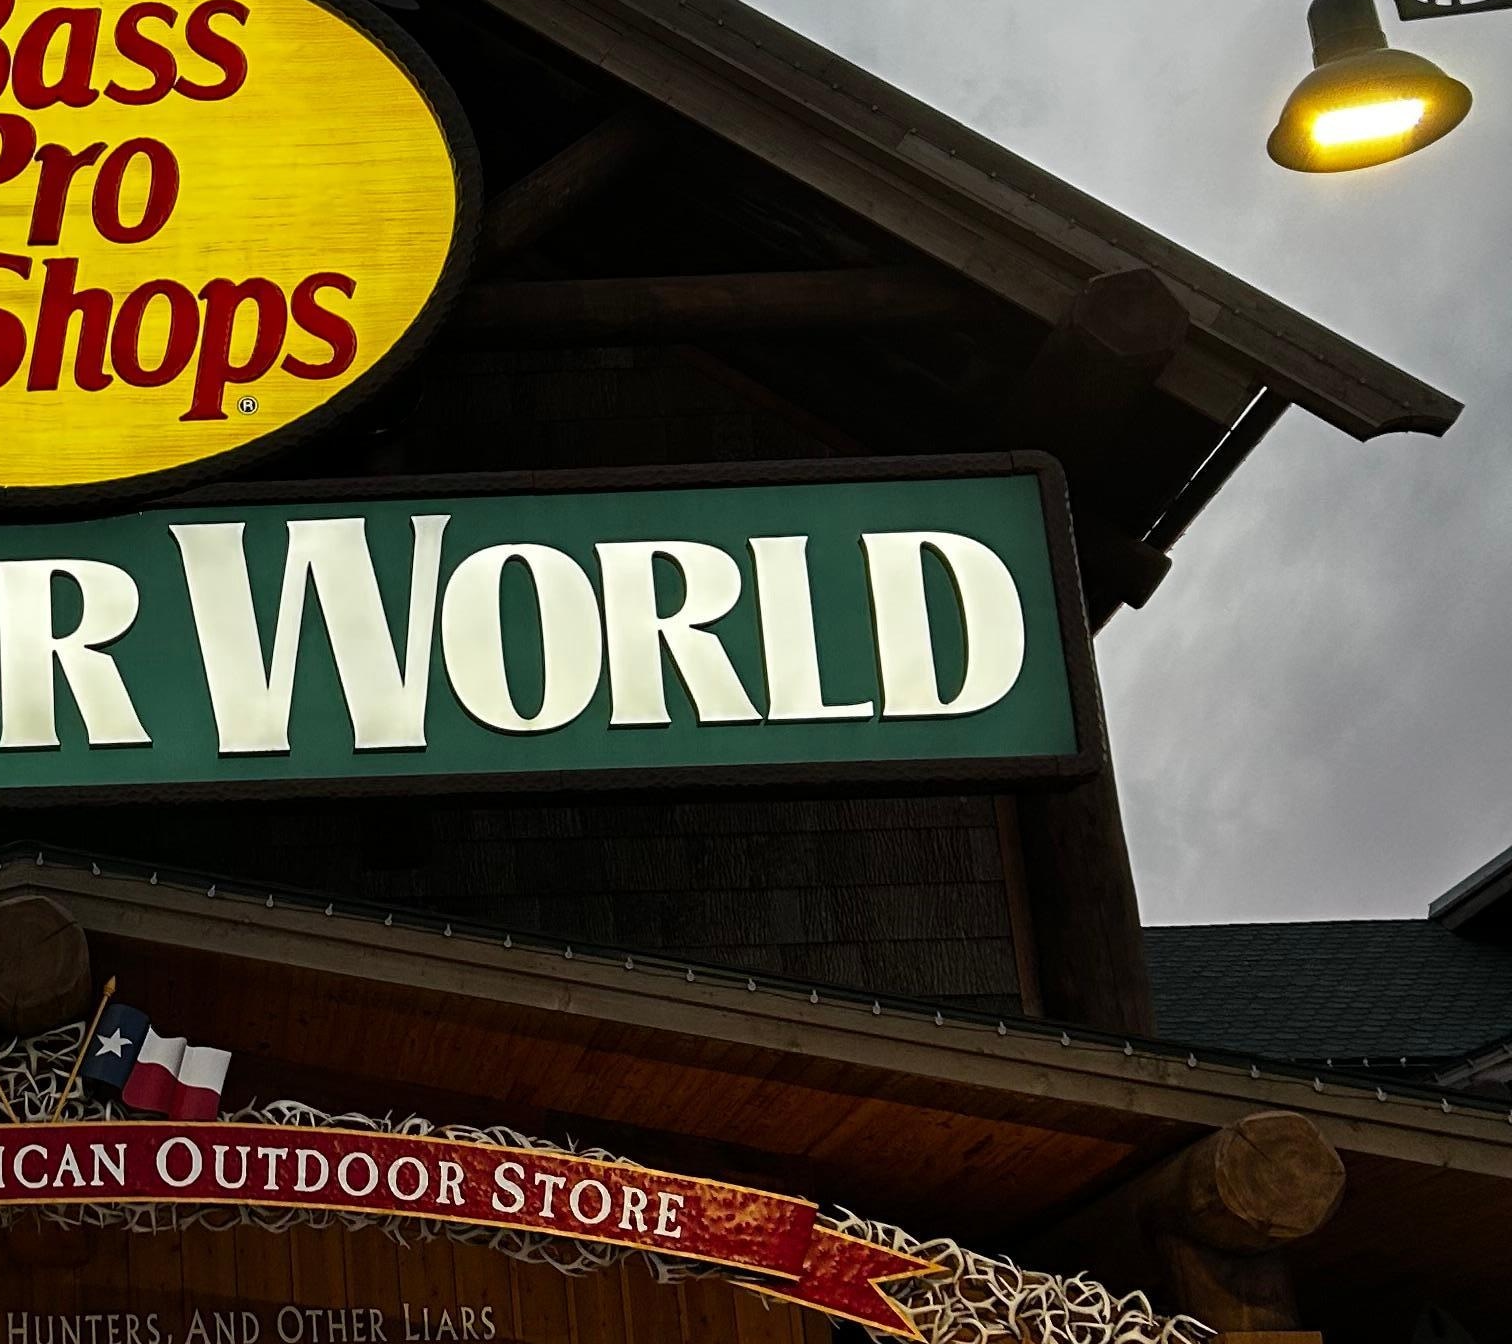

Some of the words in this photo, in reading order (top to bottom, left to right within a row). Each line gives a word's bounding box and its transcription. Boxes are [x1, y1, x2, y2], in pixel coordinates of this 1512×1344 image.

[168, 514, 1025, 754] WORLD
[155, 1136, 466, 1207] OUTDOOR
[491, 1160, 685, 1240] STORE
[276, 1305, 389, 1344] OTHER
[402, 1302, 497, 1342] LIARS
